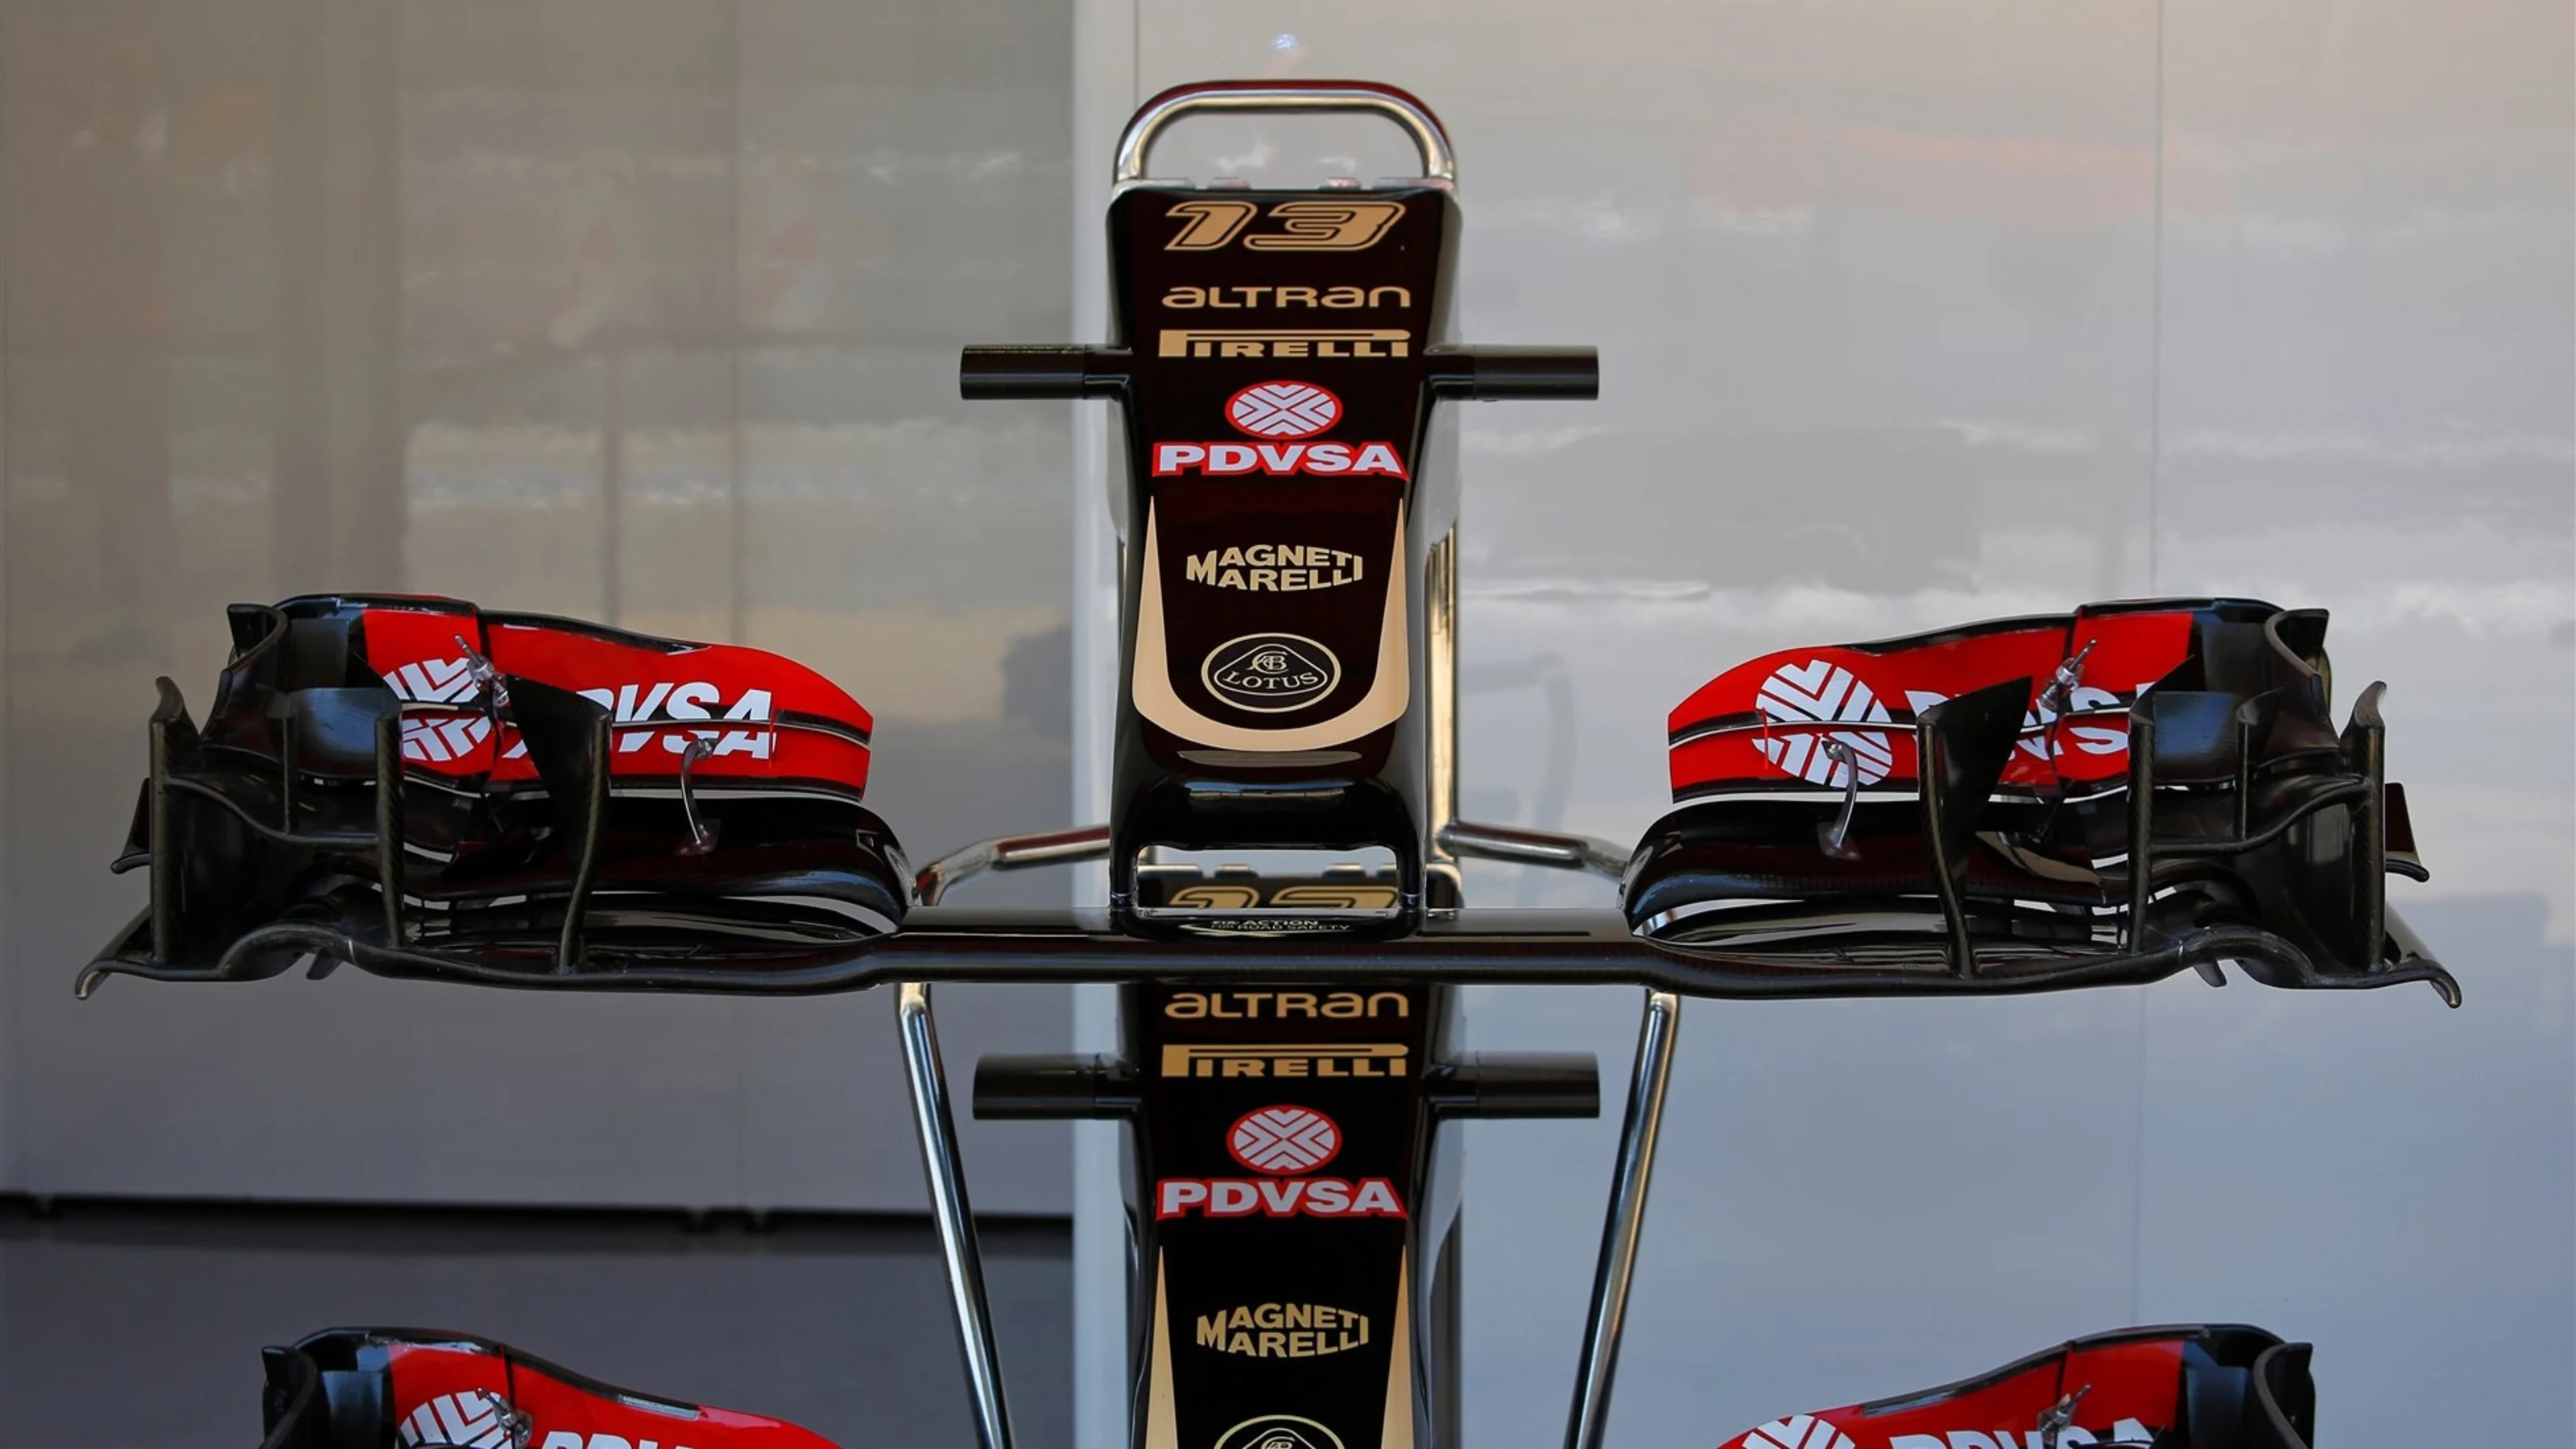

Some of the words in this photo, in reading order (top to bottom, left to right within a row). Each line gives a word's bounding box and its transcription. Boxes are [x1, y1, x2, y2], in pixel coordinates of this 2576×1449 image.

[1164, 200, 1406, 251] 13
[1158, 328, 1411, 357] PIRELLI
[1156, 444, 1405, 473] PDVSA
[1186, 543, 1363, 575] MAGNETI
[1186, 562, 1363, 592] MARELLI
[1224, 671, 1318, 689] LOTUS
[577, 681, 776, 760] VSA
[1161, 1043, 1408, 1077] PIRELLI
[1161, 1181, 1401, 1214] PDVSA
[1197, 1302, 1369, 1337] MAGNETI
[1197, 1323, 1369, 1358] MARELLI
